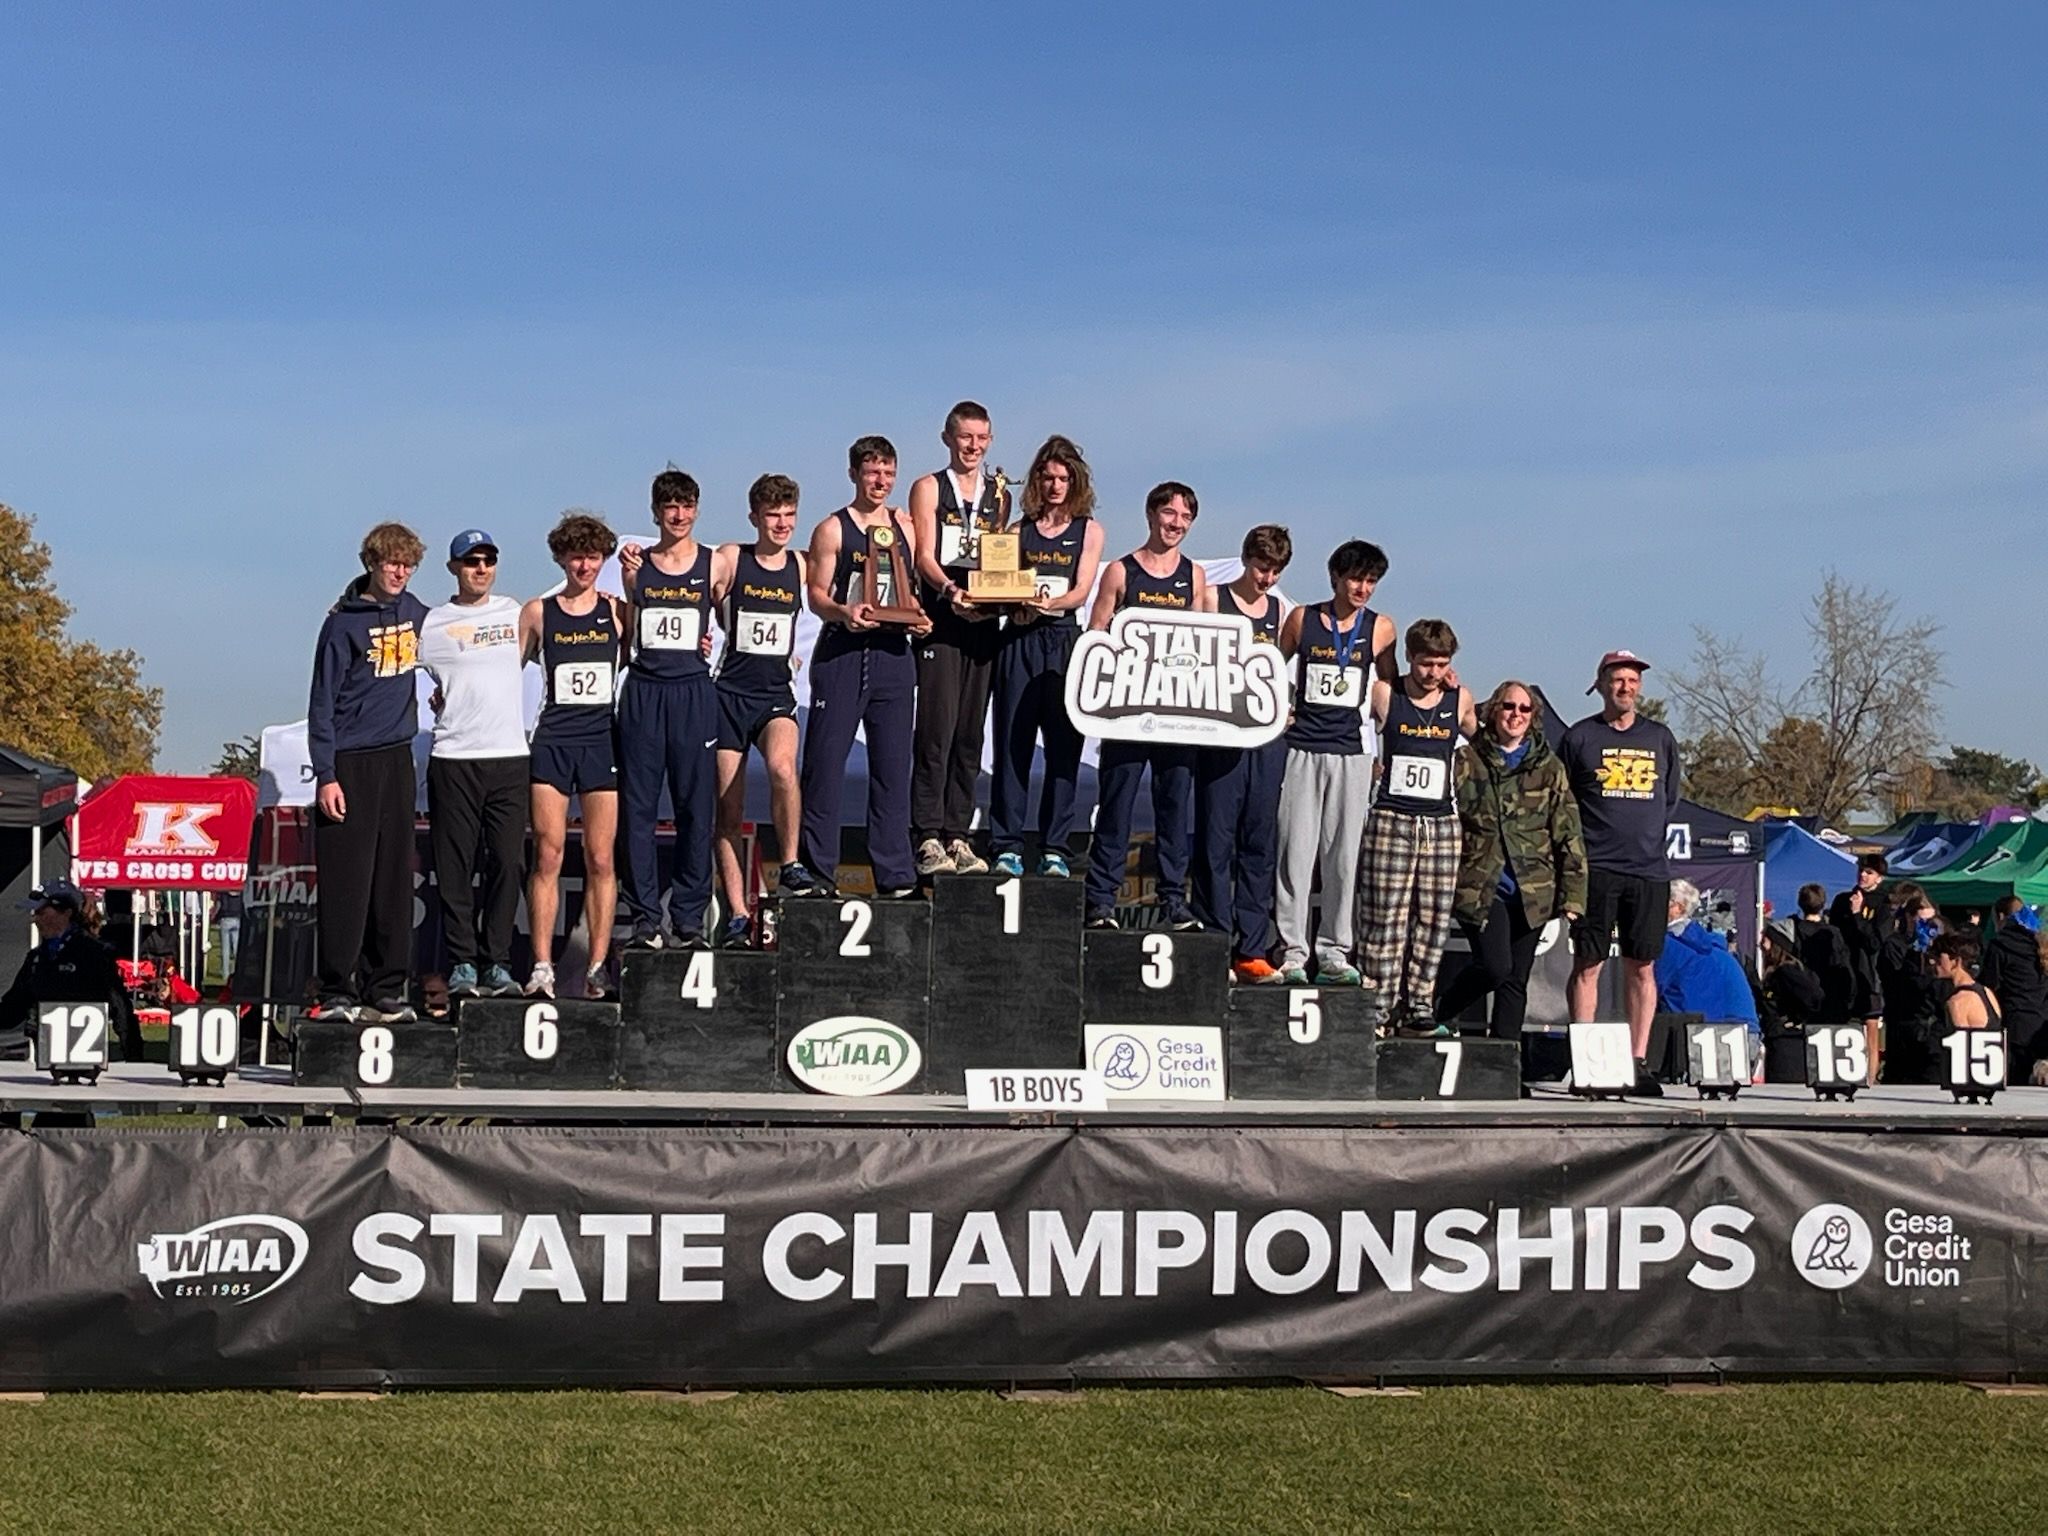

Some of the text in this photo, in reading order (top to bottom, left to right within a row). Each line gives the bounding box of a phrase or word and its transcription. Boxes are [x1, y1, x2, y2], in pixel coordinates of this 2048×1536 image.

[656, 616, 682, 641] 49
[752, 621, 778, 646] 54
[1123, 622, 1239, 664] STATE
[572, 671, 598, 695] 52
[1080, 644, 1277, 725] CHAMPS
[1406, 765, 1430, 789] 50
[126, 801, 223, 851] K
[126, 862, 194, 879] CROSS
[839, 900, 872, 956] 2
[996, 878, 1020, 934] 1
[681, 951, 717, 1008] 4
[1141, 933, 1173, 988] 3
[42, 1006, 105, 1063] 12
[172, 1007, 237, 1066] 10
[524, 1003, 558, 1059] 6
[1288, 989, 1321, 1044] 5
[358, 1027, 393, 1084] 8
[813, 1041, 891, 1066] WIAA
[1157, 1037, 1203, 1054] Gesa
[1158, 1056, 1217, 1072] Credit
[1435, 1041, 1462, 1096] 7
[1584, 1027, 1619, 1079] 9
[1692, 1028, 1746, 1081] 11
[1808, 1029, 1866, 1082] 13
[1942, 1031, 2003, 1084] 15
[989, 1076, 1083, 1103] 1B BOYS
[1159, 1073, 1211, 1089] Union
[1885, 1208, 1953, 1234] Gesa
[167, 1238, 282, 1273] WIAA
[348, 1205, 1755, 1304] STATE CHAMPIONSHIPS
[1885, 1234, 1972, 1260] Credit
[212, 1283, 251, 1296] 1905
[1885, 1260, 1960, 1286] Union
